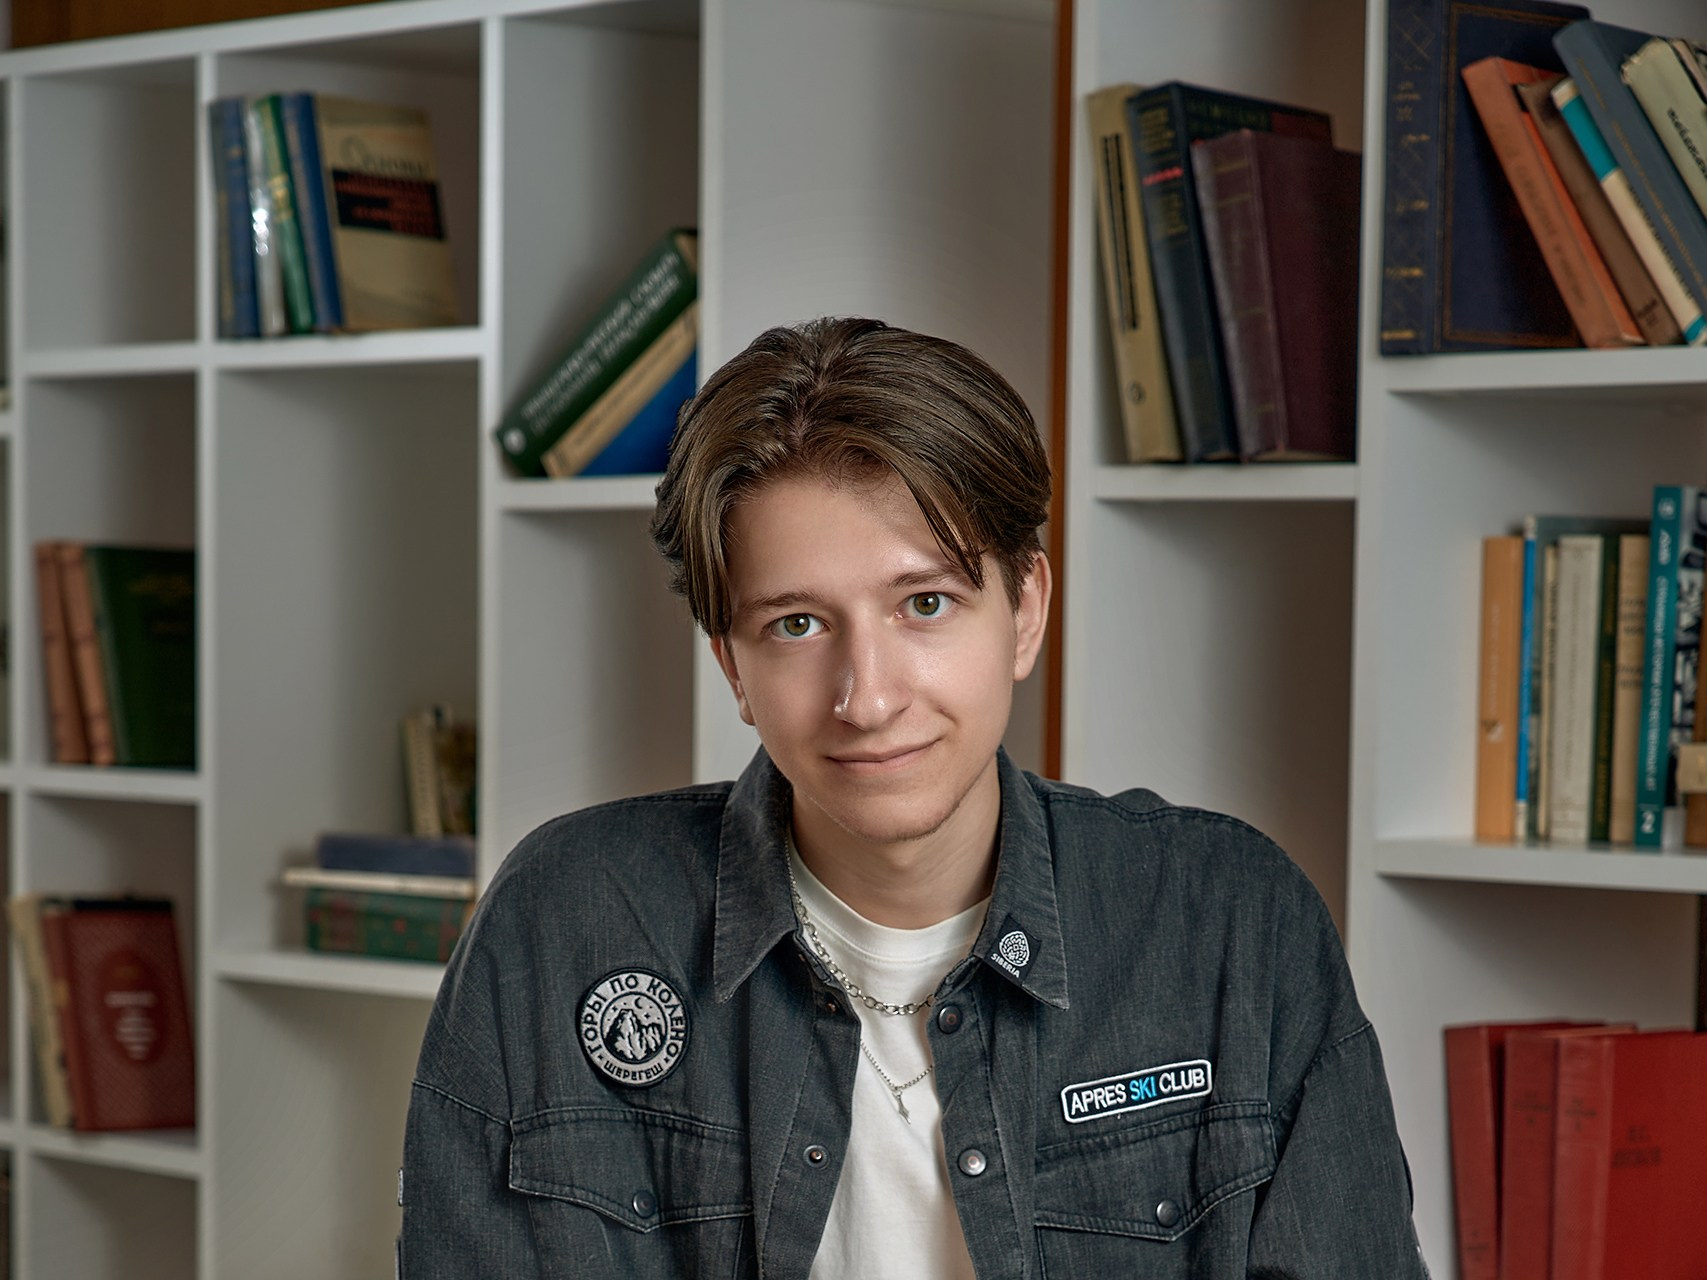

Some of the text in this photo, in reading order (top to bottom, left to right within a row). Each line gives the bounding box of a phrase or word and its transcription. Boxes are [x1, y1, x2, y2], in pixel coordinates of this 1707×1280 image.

[991, 953, 1020, 978] SIBERIA
[583, 974, 686, 1058] ГОРЫ ПО КОЛЕНО
[603, 1060, 663, 1081] ШЕРЕГЕШ
[1071, 1068, 1206, 1115] APRES SKI CLUB
